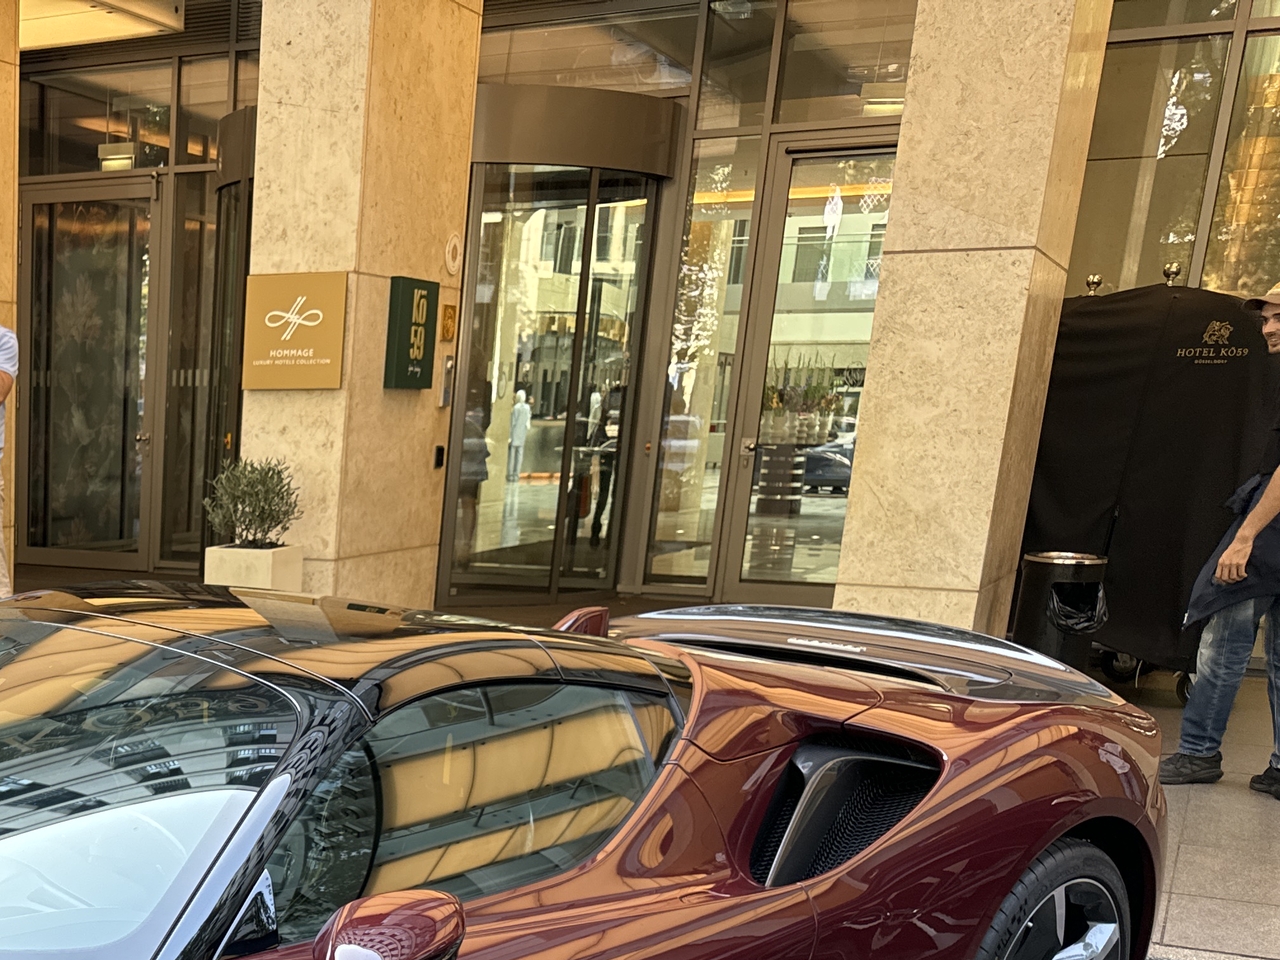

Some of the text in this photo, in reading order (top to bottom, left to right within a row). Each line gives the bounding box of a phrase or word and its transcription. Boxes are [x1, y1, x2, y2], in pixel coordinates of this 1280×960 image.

[409, 325, 424, 360] 59
[269, 348, 314, 358] HOMMAGE
[1176, 347, 1216, 357] HOTEL
